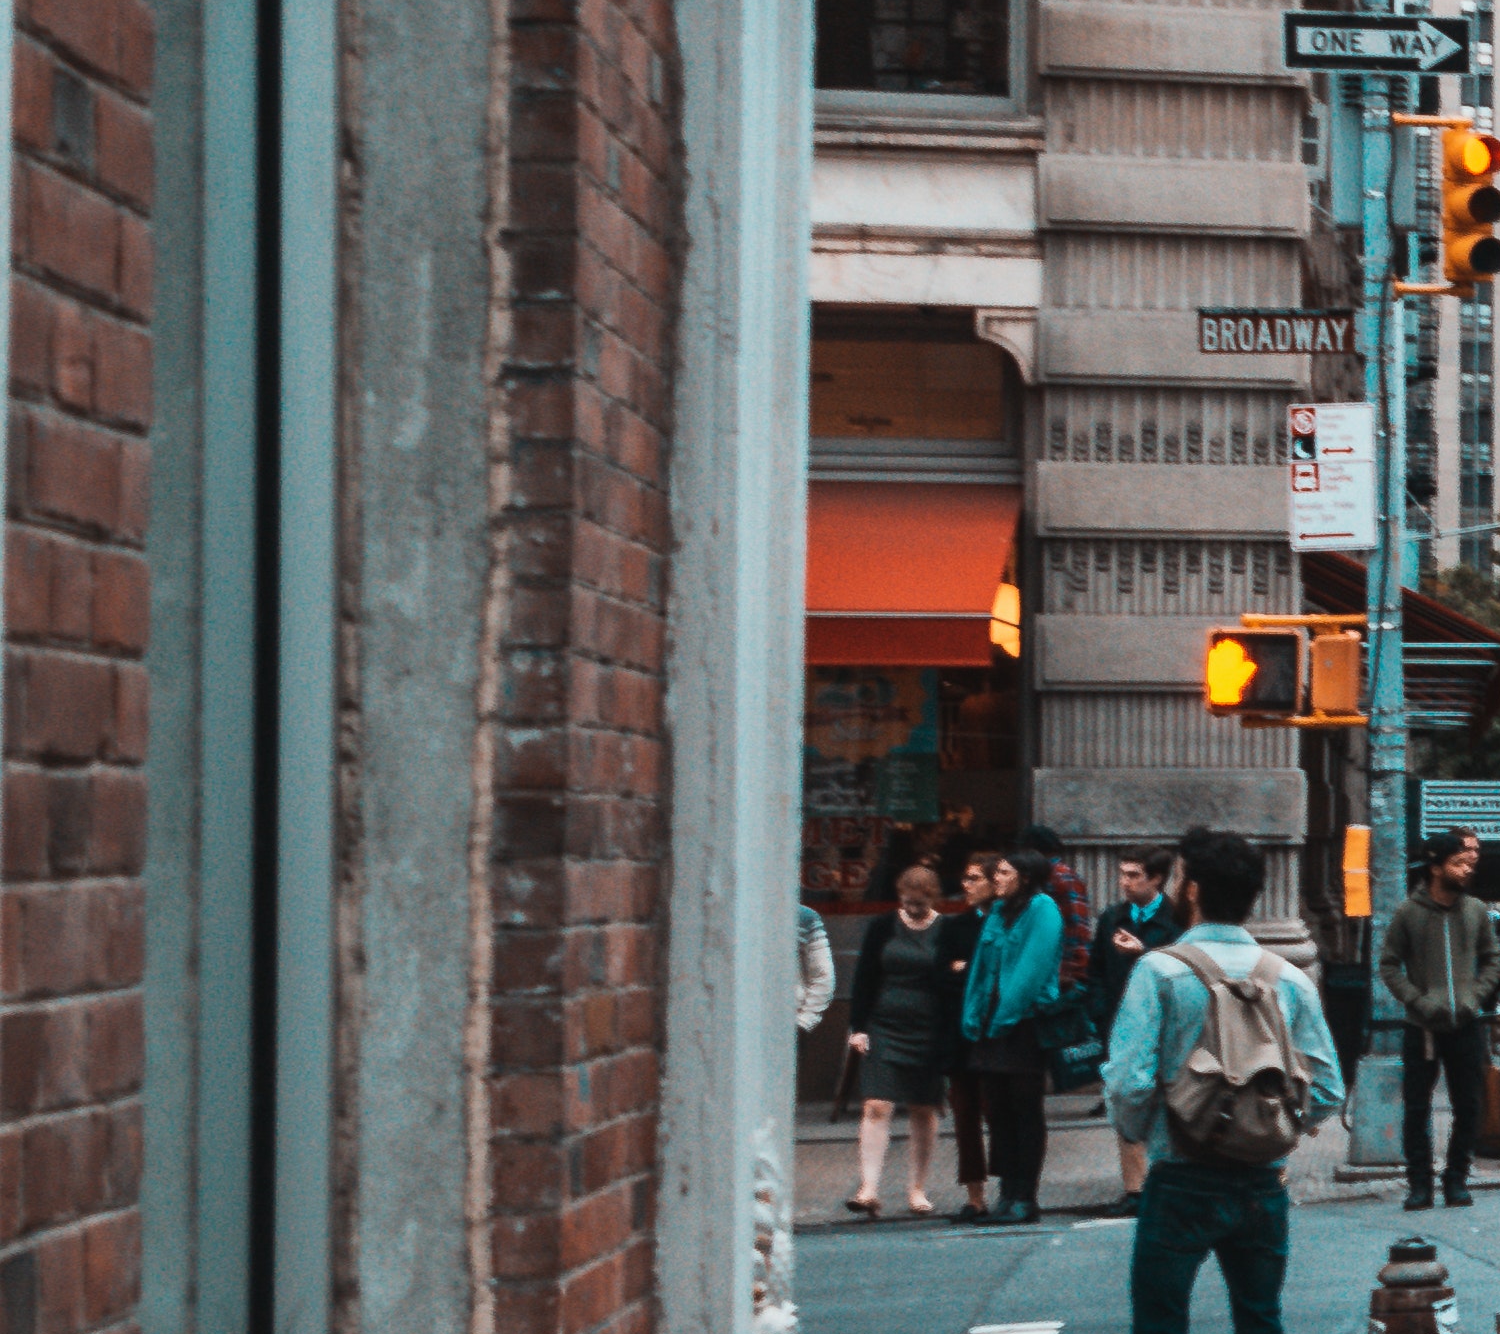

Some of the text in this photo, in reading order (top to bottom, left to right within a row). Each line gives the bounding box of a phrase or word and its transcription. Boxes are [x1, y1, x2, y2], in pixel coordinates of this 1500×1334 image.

[1312, 30, 1443, 56] ONE WAY
[1201, 317, 1351, 353] BROADWAY
